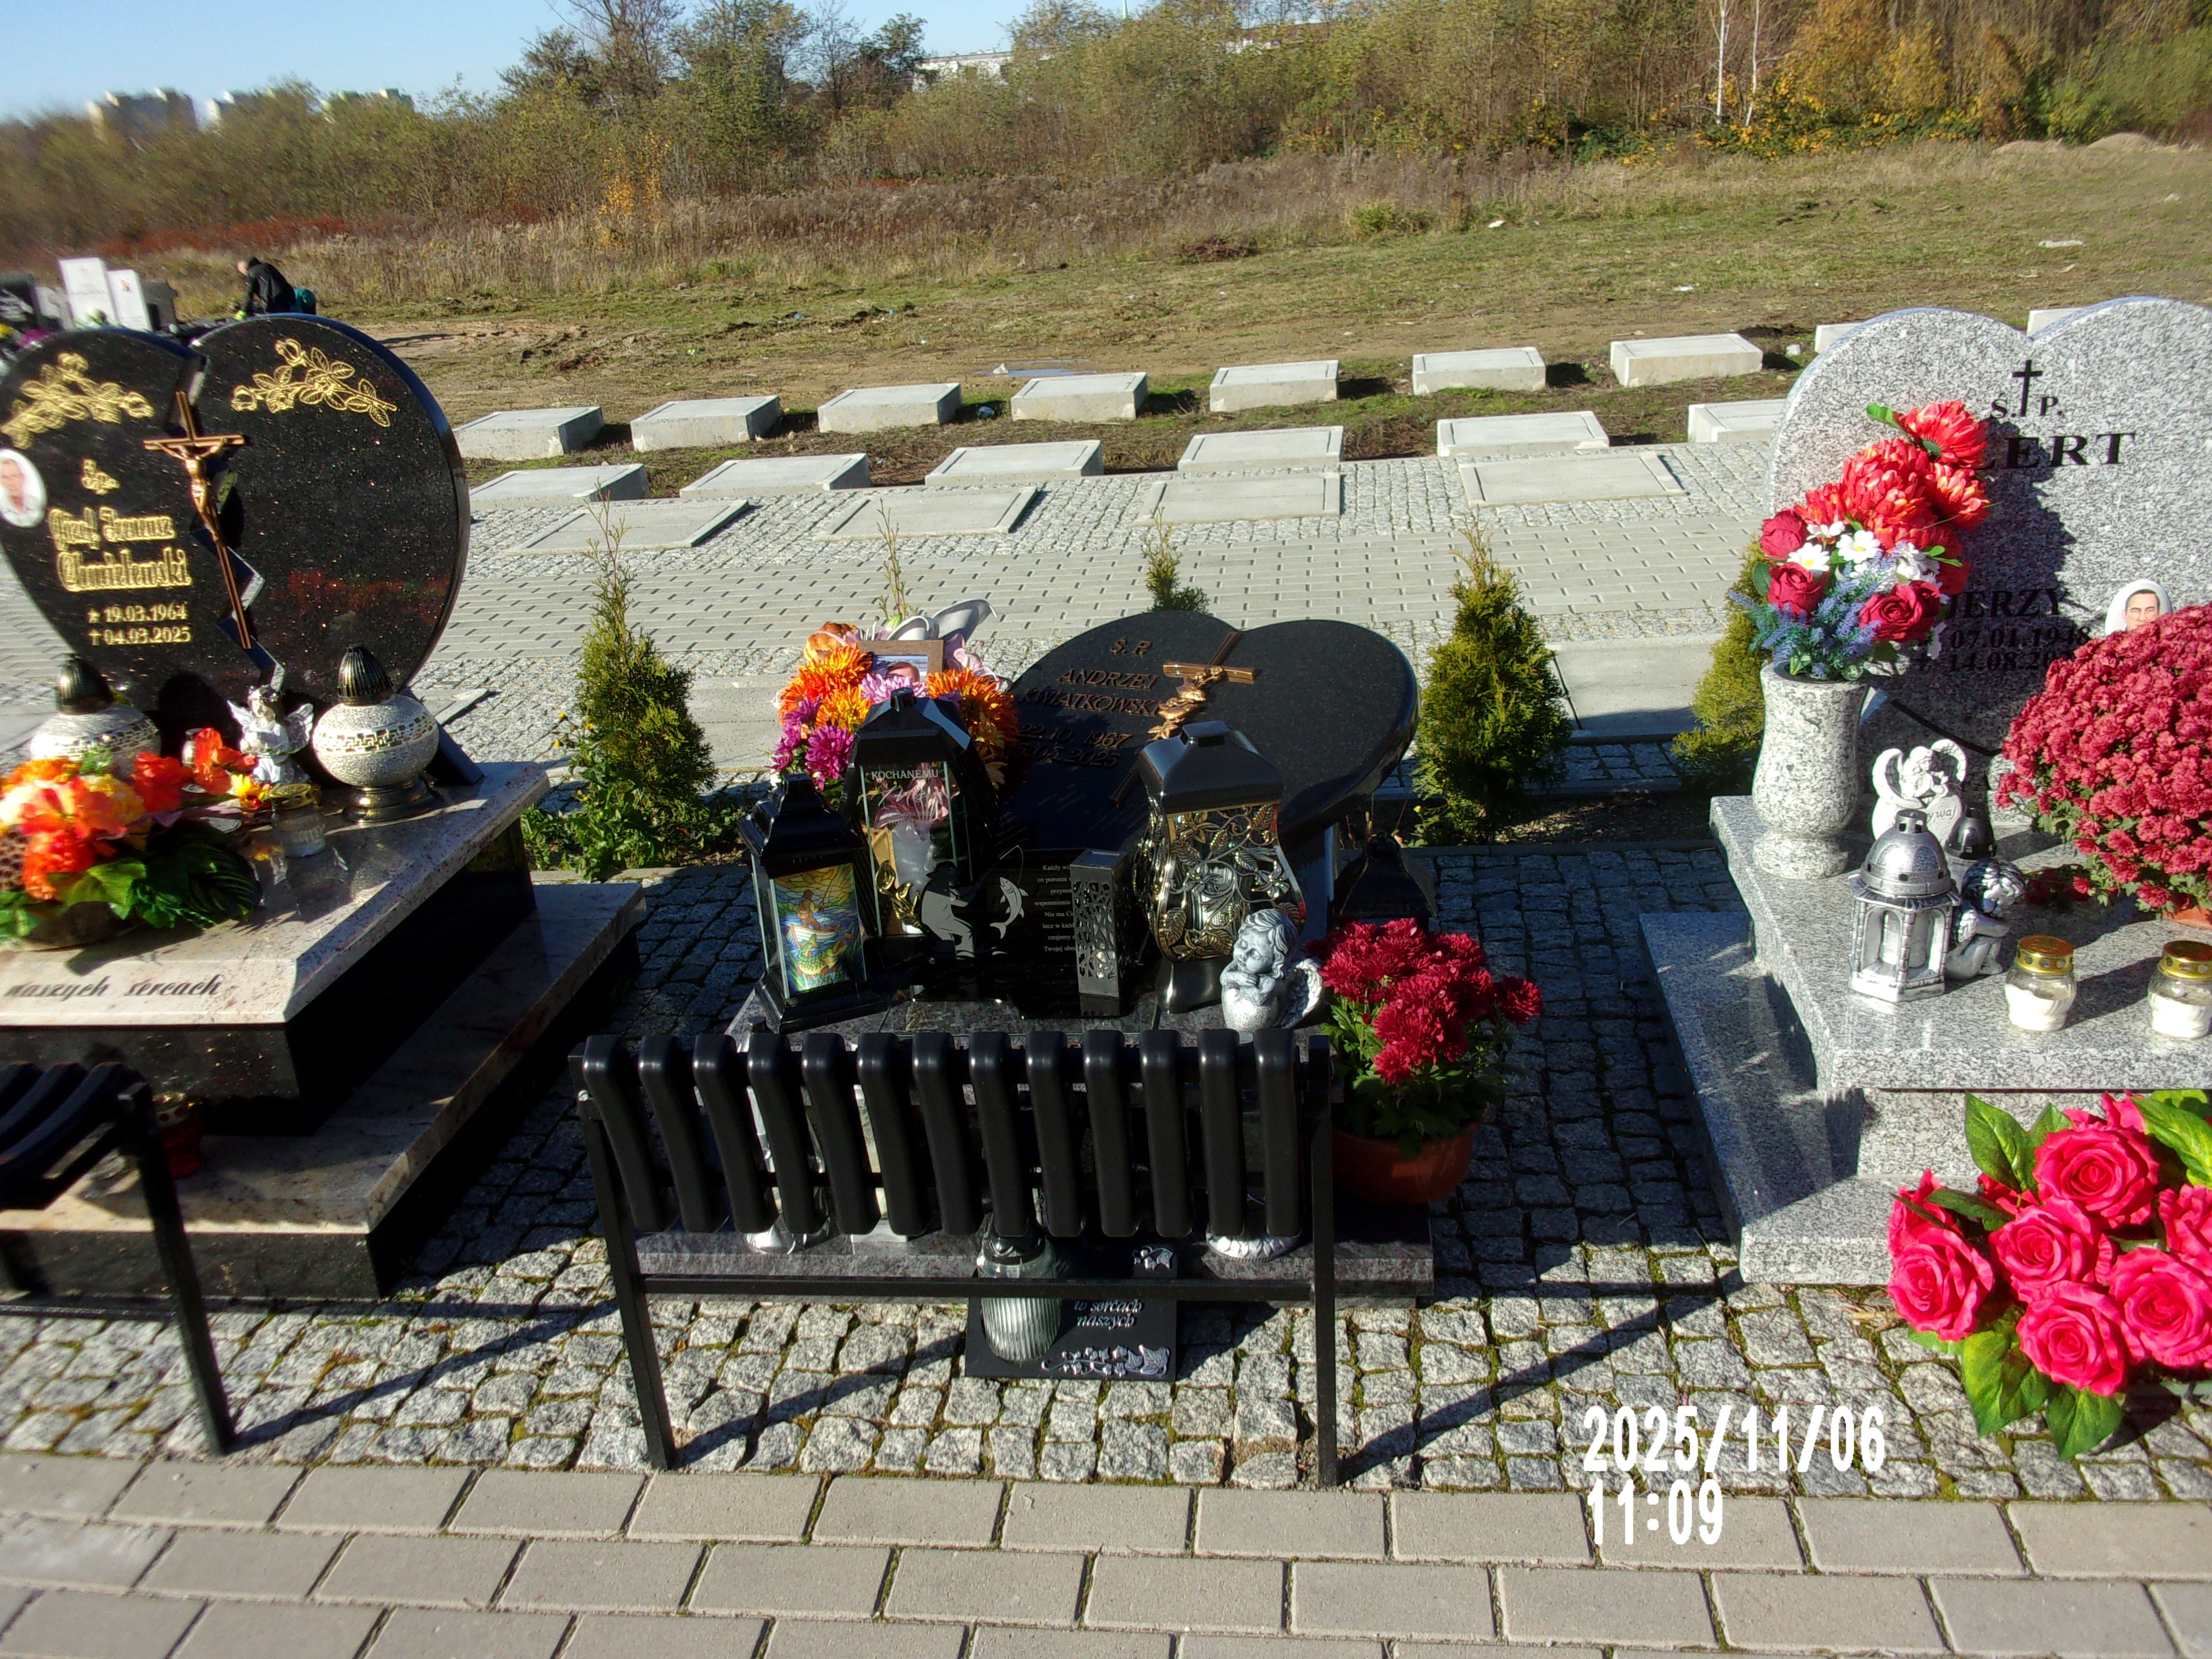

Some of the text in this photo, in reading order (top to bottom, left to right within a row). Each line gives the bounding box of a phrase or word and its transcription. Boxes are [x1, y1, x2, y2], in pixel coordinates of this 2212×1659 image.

[1975, 432, 2136, 469] ERT
[104, 603, 189, 623] 19.03.1964
[103, 626, 192, 645] 04.03.2025
[1056, 668, 1160, 690] ANDRZEJ
[1018, 687, 1162, 716] KWIATKOWSKI
[871, 769, 938, 780] KOCHANEMU
[3, 974, 223, 1002] naszych sercach
[1074, 1300, 1087, 1311] w
[1077, 1312, 1135, 1331] naszych
